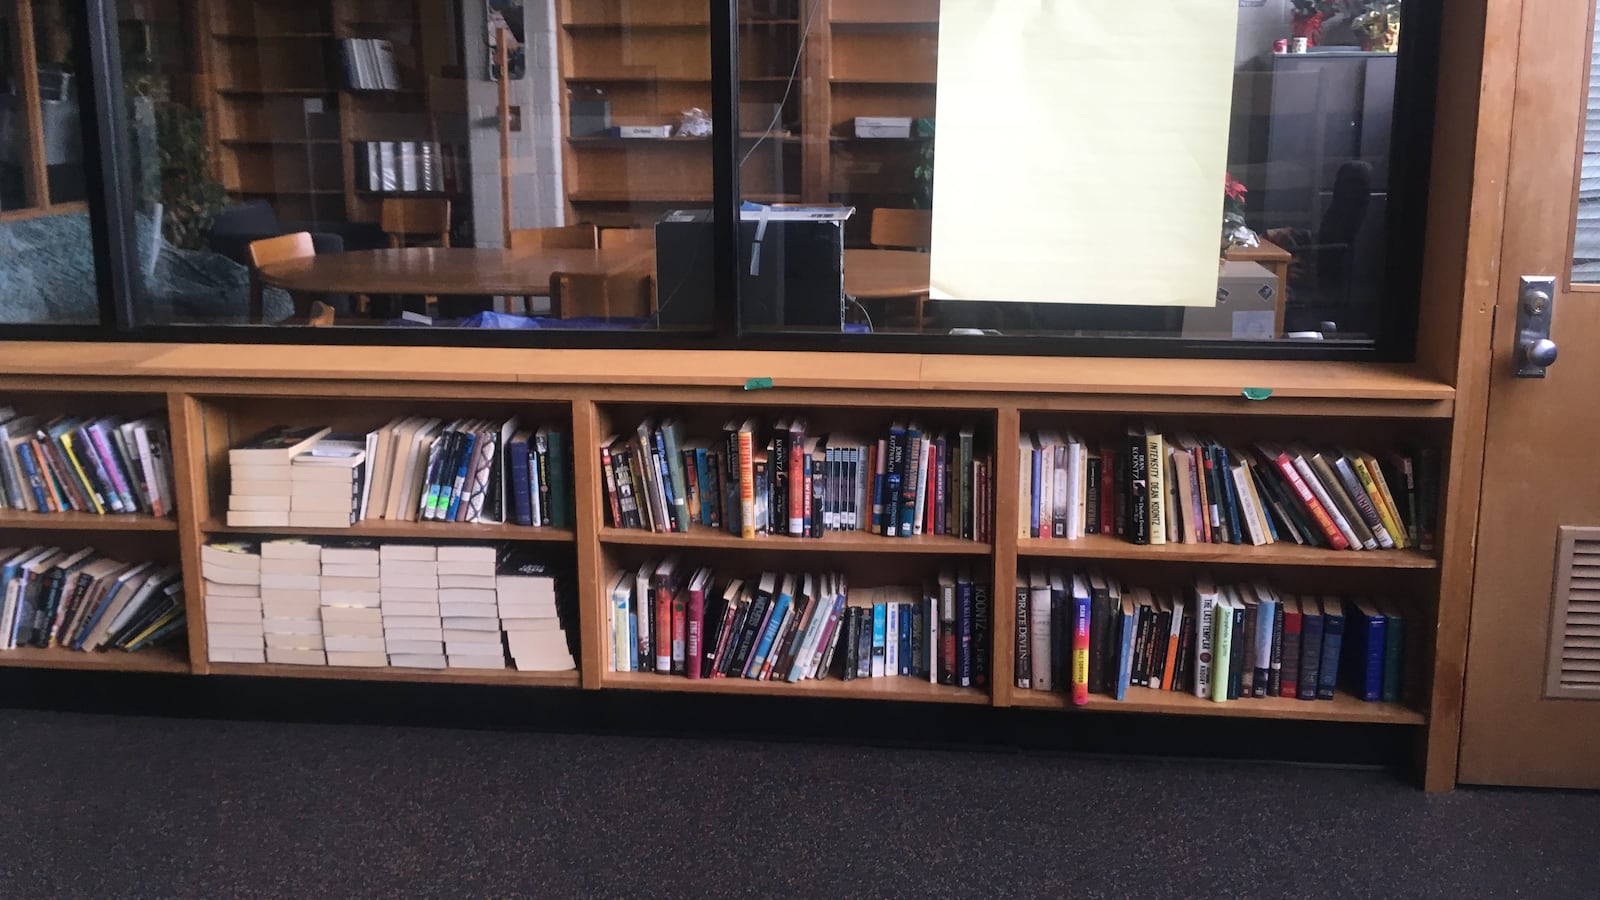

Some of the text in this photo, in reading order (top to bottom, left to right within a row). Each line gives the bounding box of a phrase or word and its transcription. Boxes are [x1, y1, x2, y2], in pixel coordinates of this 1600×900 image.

[1150, 442, 1160, 526] INTENSITY DEAN KOONTZ
[976, 589, 986, 630] KOONTZ
[1018, 593, 1028, 625] PIRATE
[1204, 610, 1212, 625] LAST
[1018, 627, 1030, 660] DEVLIN
[1202, 626, 1210, 650] TEMPLAR
